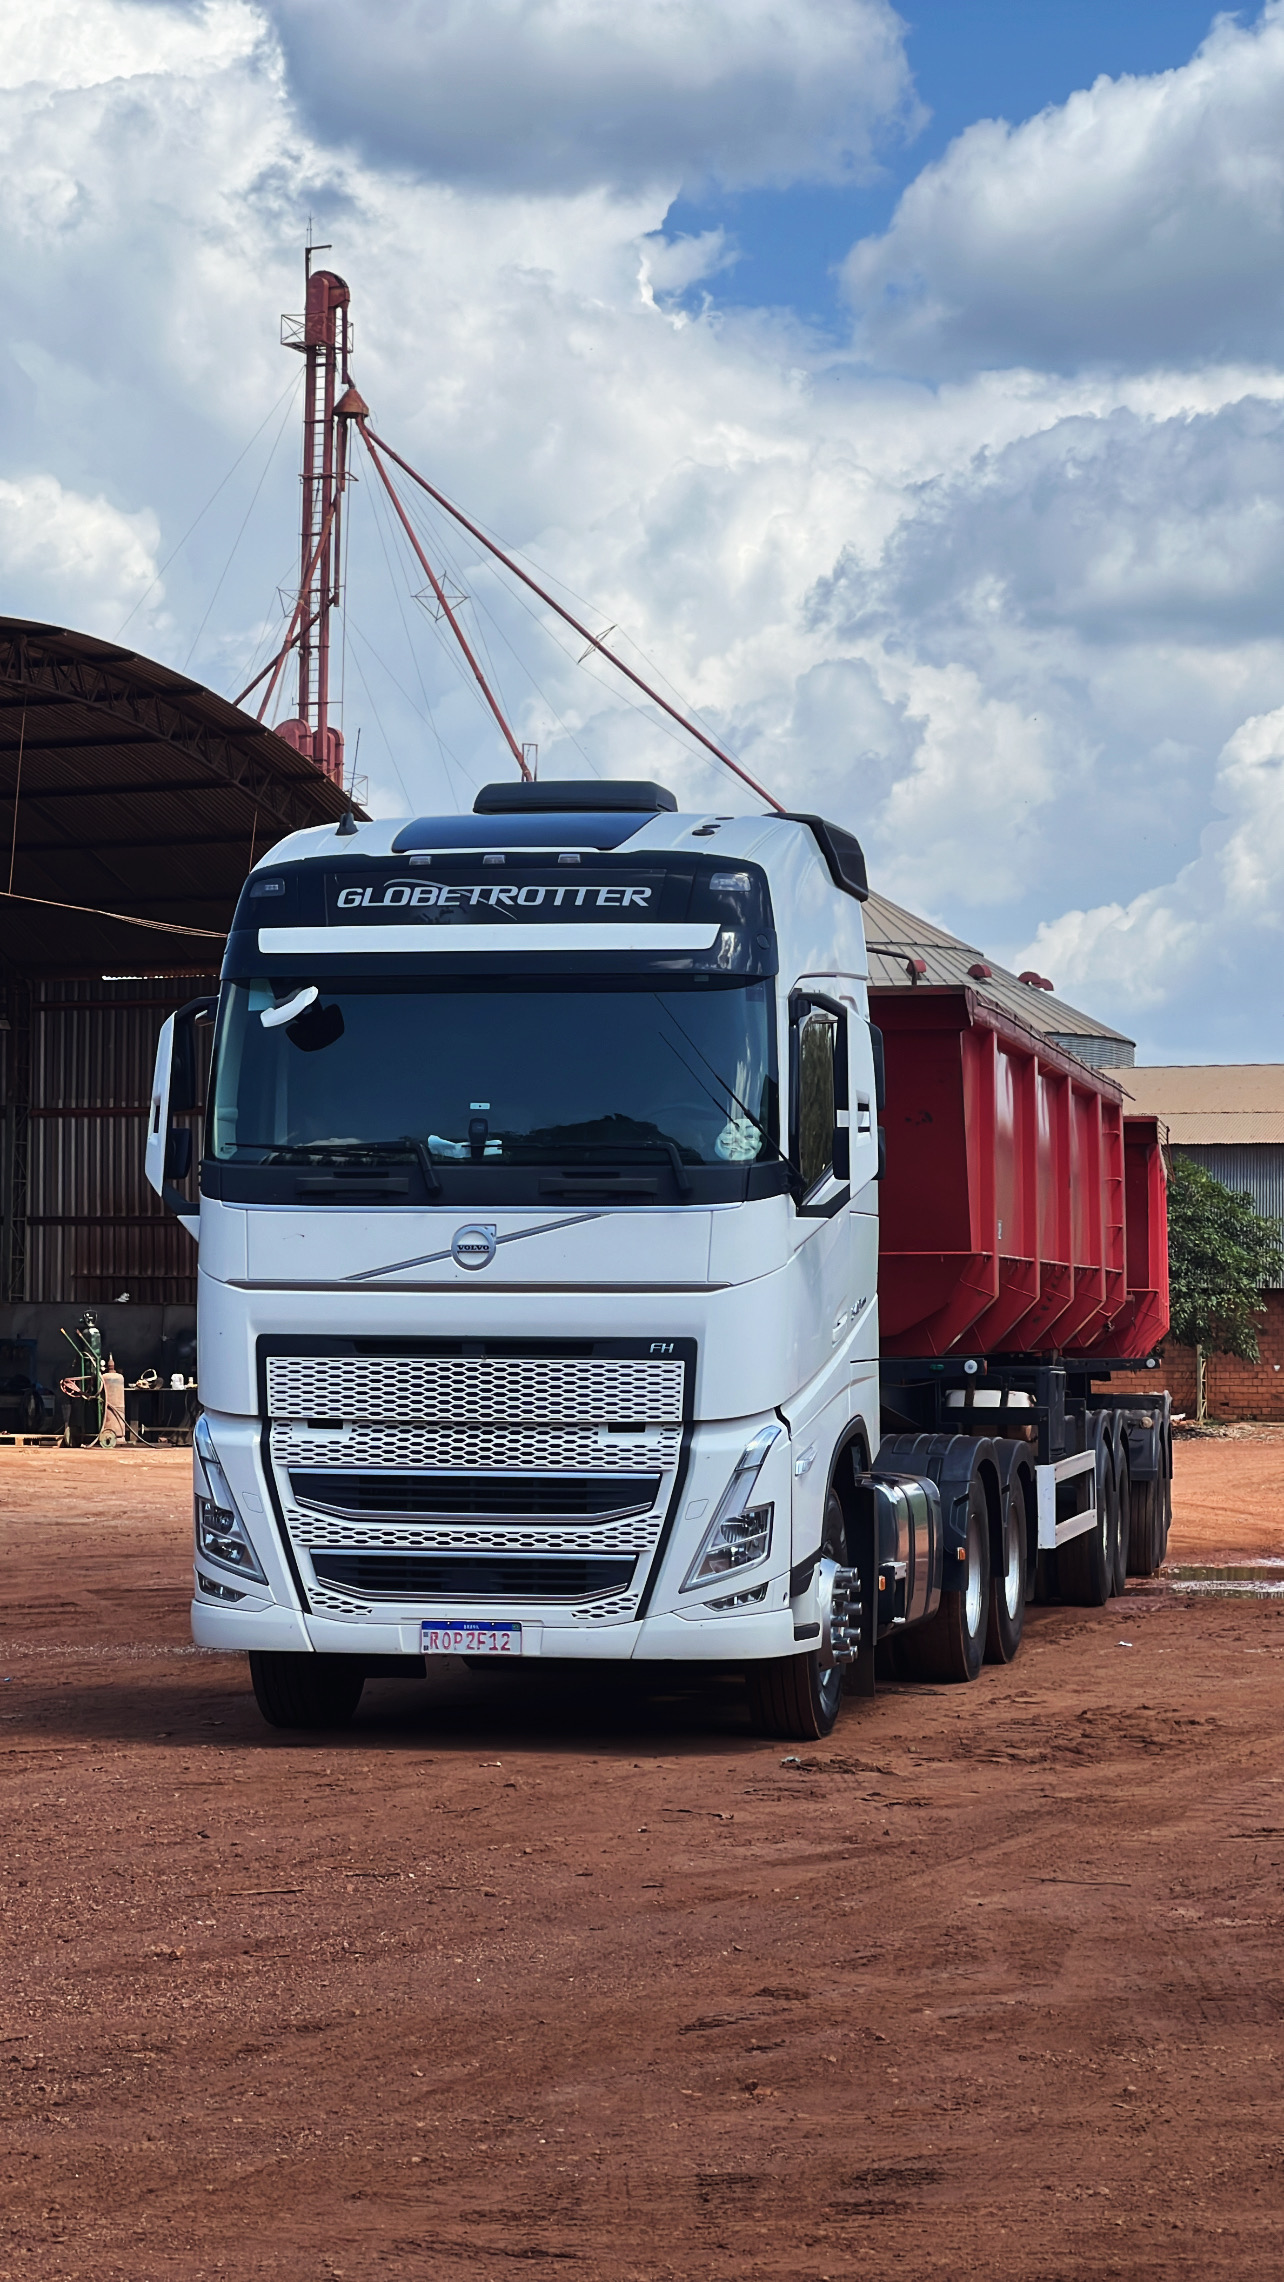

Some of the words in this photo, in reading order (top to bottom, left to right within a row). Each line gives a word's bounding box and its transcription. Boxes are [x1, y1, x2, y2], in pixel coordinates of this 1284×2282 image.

[336, 885, 652, 908] GLOBETROTTER
[649, 1342, 675, 1353] FH
[429, 1630, 511, 1652] ROP2F12
